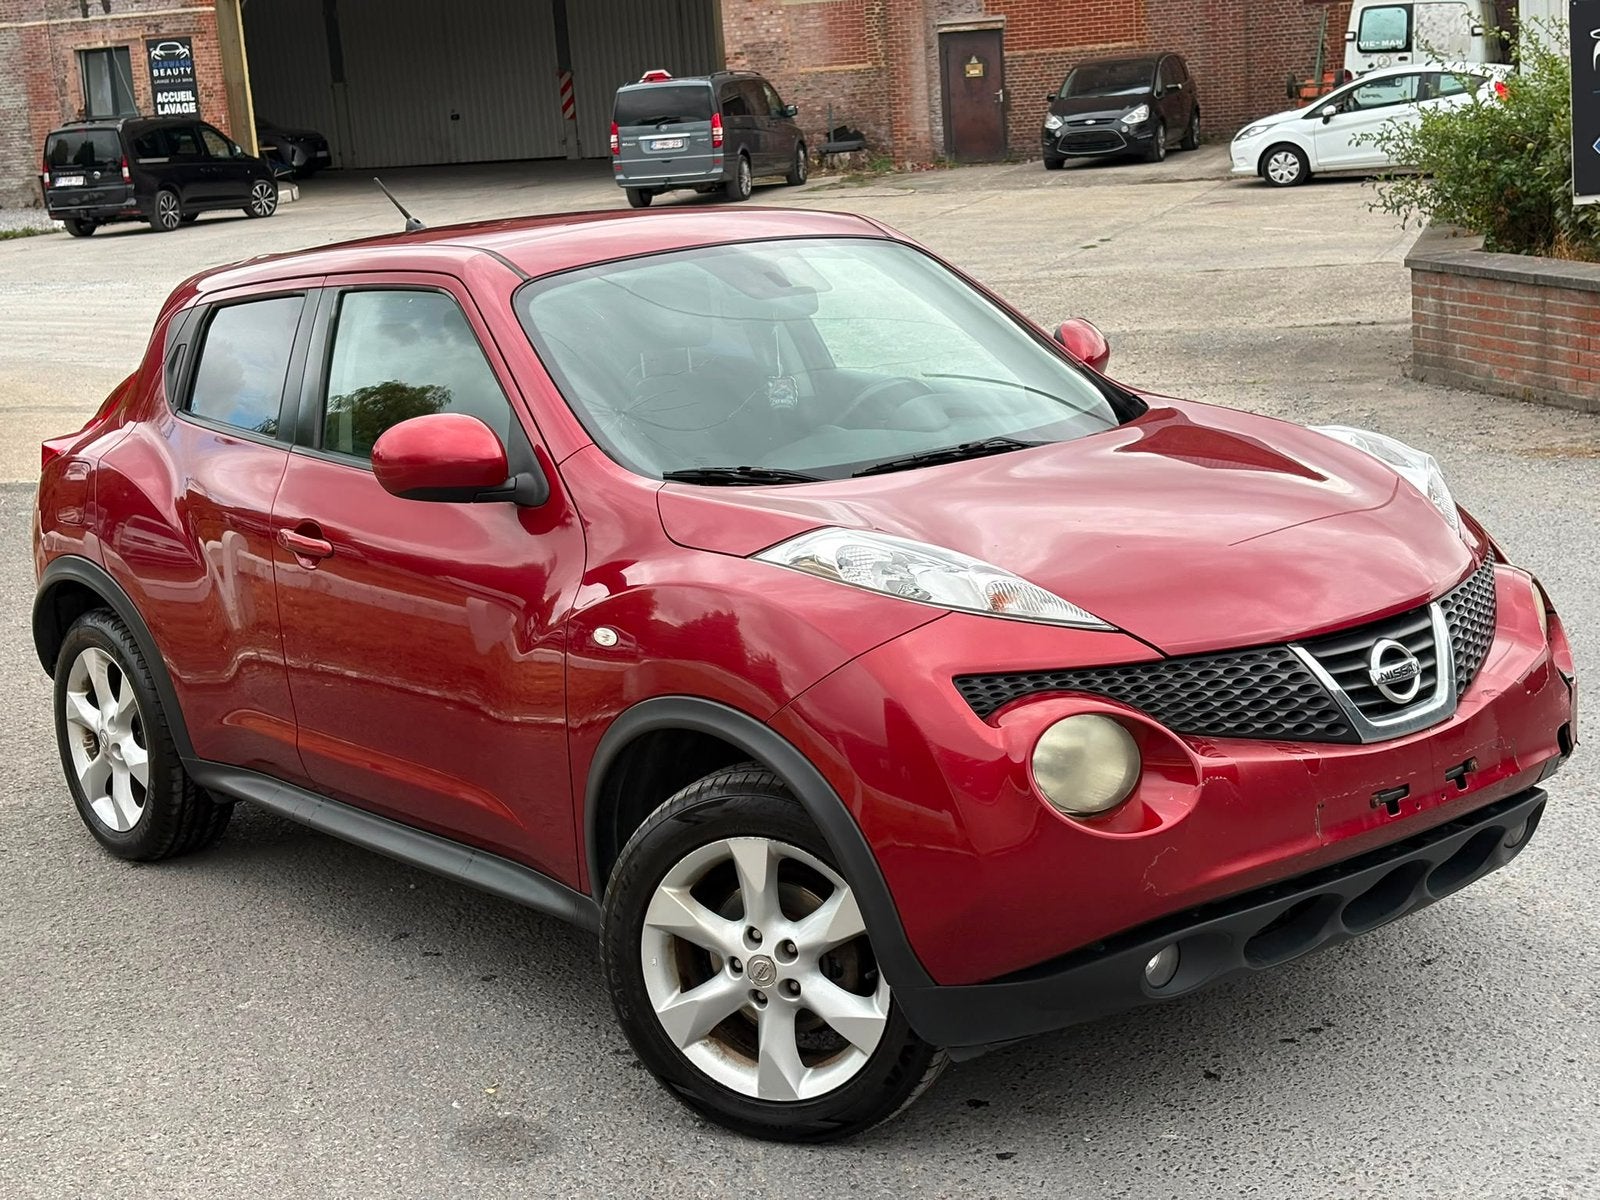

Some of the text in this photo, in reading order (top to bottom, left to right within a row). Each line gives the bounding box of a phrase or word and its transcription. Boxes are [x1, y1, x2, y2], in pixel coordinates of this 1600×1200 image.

[152, 67, 191, 77] BEAUTY
[157, 90, 195, 103] ACCUEIL
[157, 102, 197, 115] LAVAGE
[1379, 661, 1420, 681] NISSAN
